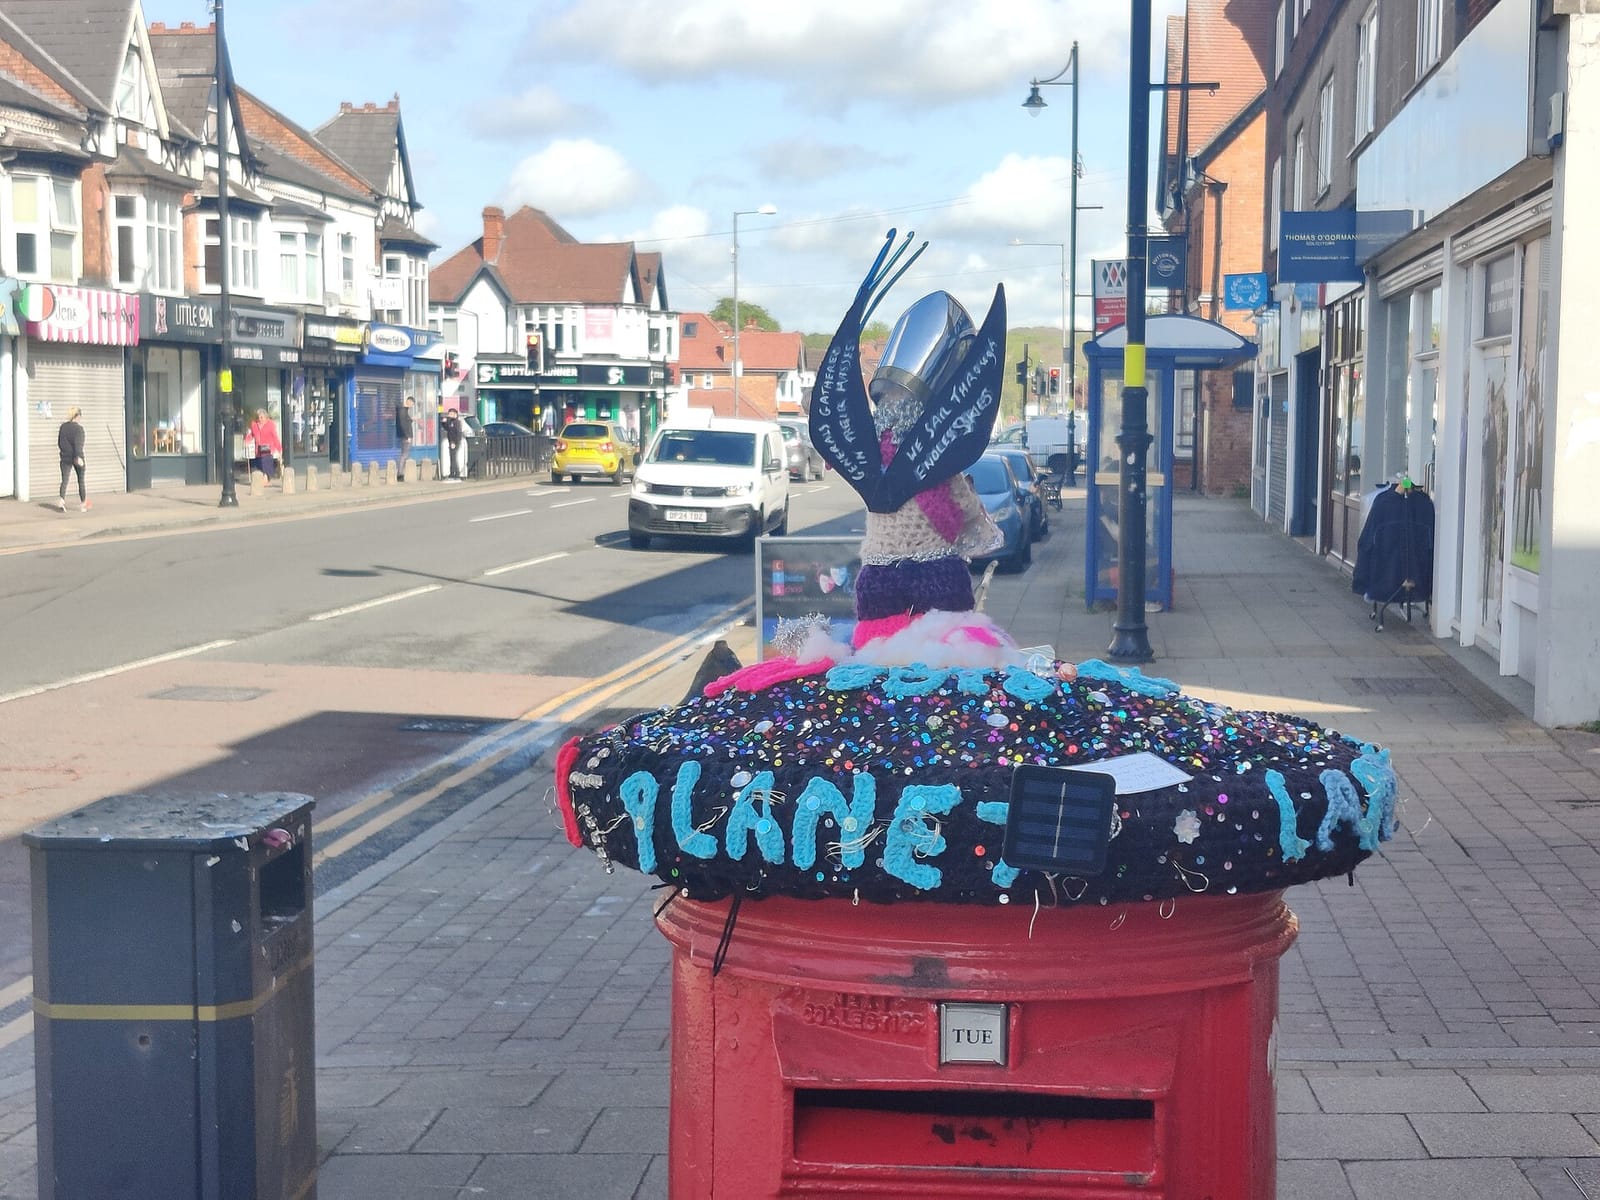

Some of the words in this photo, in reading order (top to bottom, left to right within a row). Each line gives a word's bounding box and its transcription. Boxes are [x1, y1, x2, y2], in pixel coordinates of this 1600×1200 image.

[818, 426, 865, 481] GENERALS
[855, 450, 868, 465] IN
[906, 438, 923, 462] WE
[951, 1028, 993, 1045] TUE
